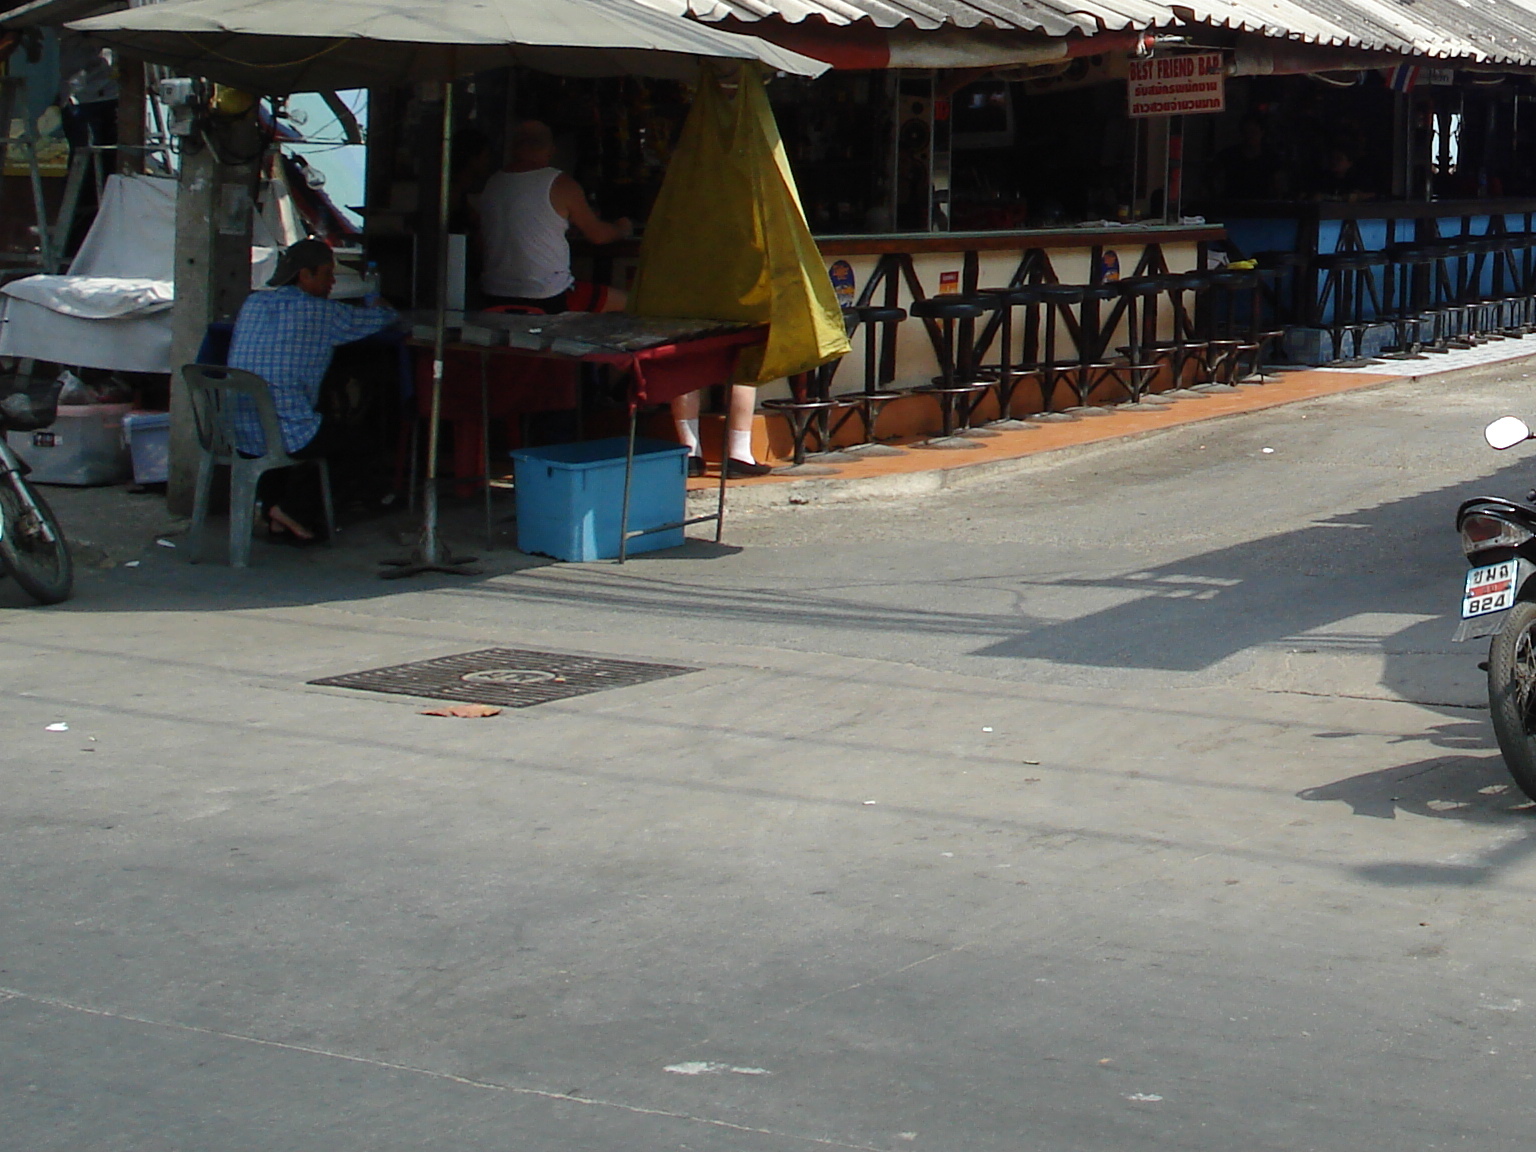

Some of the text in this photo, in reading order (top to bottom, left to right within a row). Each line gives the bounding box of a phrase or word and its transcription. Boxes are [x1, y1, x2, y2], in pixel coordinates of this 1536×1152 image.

[1130, 60, 1154, 81] BEST
[1157, 57, 1194, 79] FRIEND
[1469, 594, 1506, 614] 824
